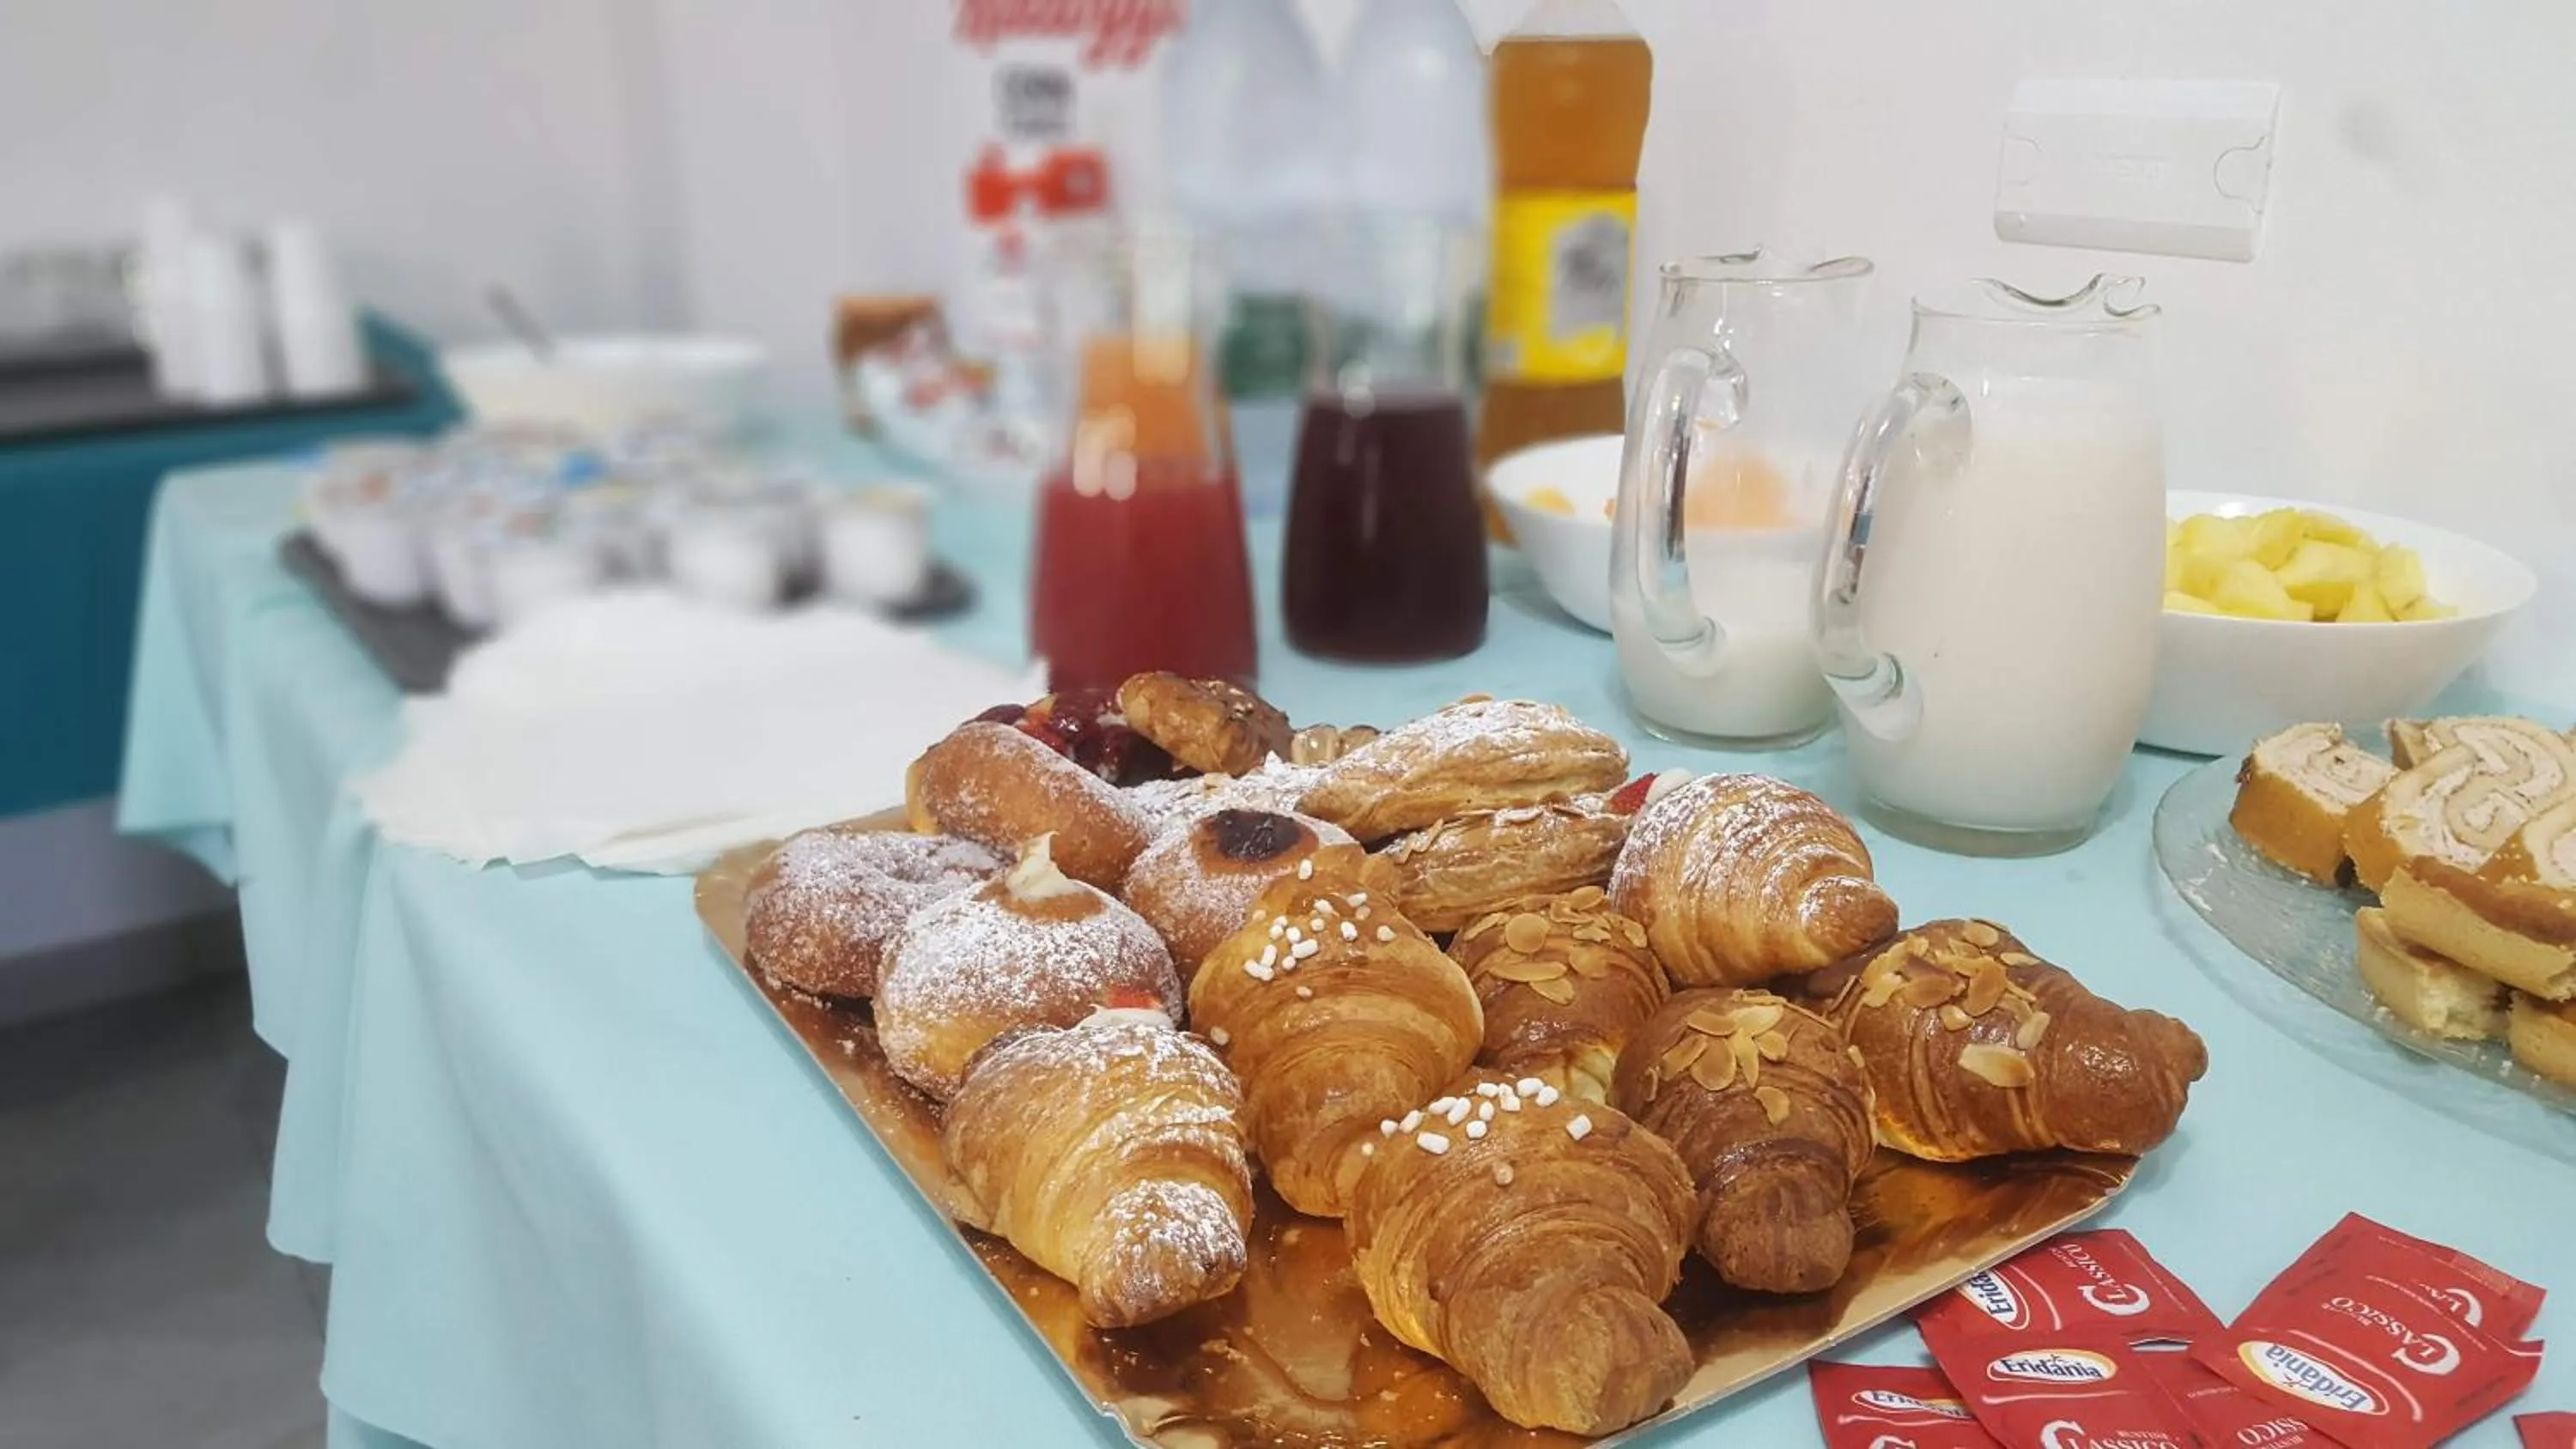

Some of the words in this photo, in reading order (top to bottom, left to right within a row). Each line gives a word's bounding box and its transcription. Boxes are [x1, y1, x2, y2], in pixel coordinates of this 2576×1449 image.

[2330, 1296, 2461, 1375] CLASSICO
[2001, 1358, 2104, 1380] Eridania
[2264, 1344, 2368, 1410] Eridania
